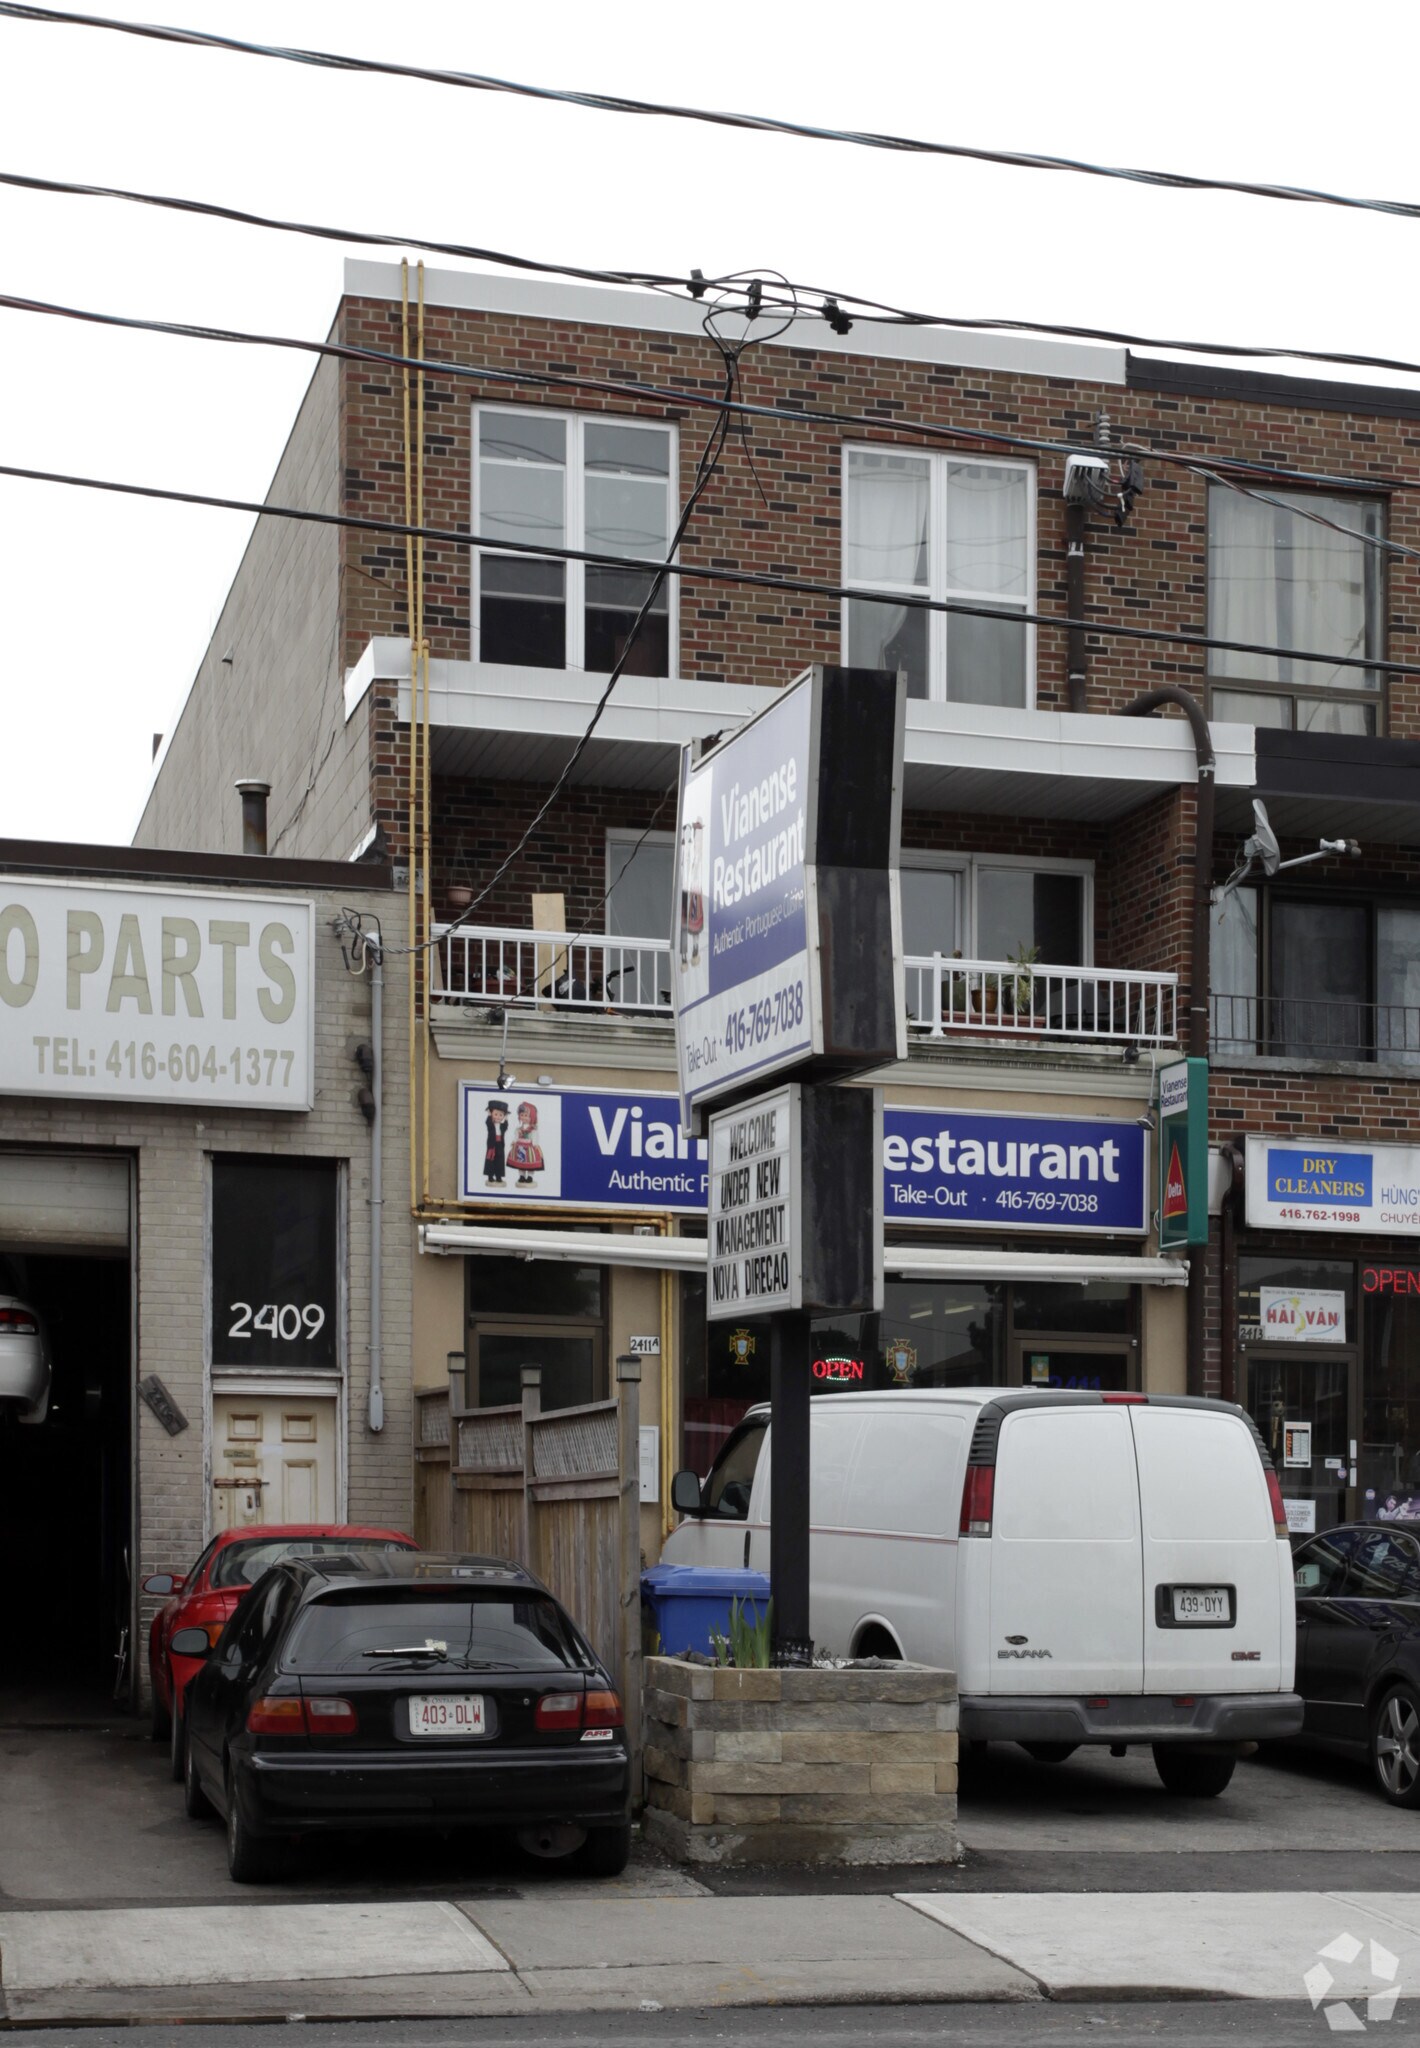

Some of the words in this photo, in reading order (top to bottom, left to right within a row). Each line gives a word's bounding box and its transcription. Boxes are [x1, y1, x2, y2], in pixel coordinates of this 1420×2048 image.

[721, 757, 797, 847] Vianense
[712, 807, 804, 914] Restaurant
[713, 921, 744, 956] Authentic
[745, 906, 783, 938] Portuguese
[783, 888, 804, 919] Cuisine
[66, 909, 296, 1024] PARTS
[686, 1035, 718, 1073] Take-Out
[725, 980, 803, 1055] 416-769-7038
[33, 1036, 96, 1076] TEL:
[105, 1040, 295, 1087] 416-604-1377
[1162, 1078, 1187, 1094] Vianense
[588, 1105, 708, 1161] Vian
[883, 1130, 1120, 1183] estaurant
[729, 1109, 777, 1162] WELCOME
[1303, 1158, 1338, 1174] DRY
[608, 1169, 695, 1193] Authentic
[721, 1166, 750, 1210] UNDER
[756, 1157, 781, 1200] NEW
[1168, 1182, 1182, 1199] Delta
[1275, 1178, 1365, 1197] CLEANERS
[890, 1184, 968, 1206] Take-Out
[996, 1190, 1098, 1212] 416-769-7038
[1279, 1208, 1361, 1223] 416.762-1998
[1380, 1211, 1420, 1225] CHUYÊ
[716, 1204, 785, 1257] MANAGEMENT
[713, 1263, 739, 1301] NOVA
[745, 1251, 789, 1296] DIRECAO
[1362, 1268, 1420, 1294] OPEN
[228, 1302, 326, 1341] 2409
[1240, 1327, 1263, 1340] 2413
[813, 1360, 864, 1380] OPEN
[1180, 1596, 1199, 1613] 439
[997, 1649, 1053, 1659] SAVANA
[1231, 1651, 1261, 1661] GMC
[422, 1705, 447, 1725] 403
